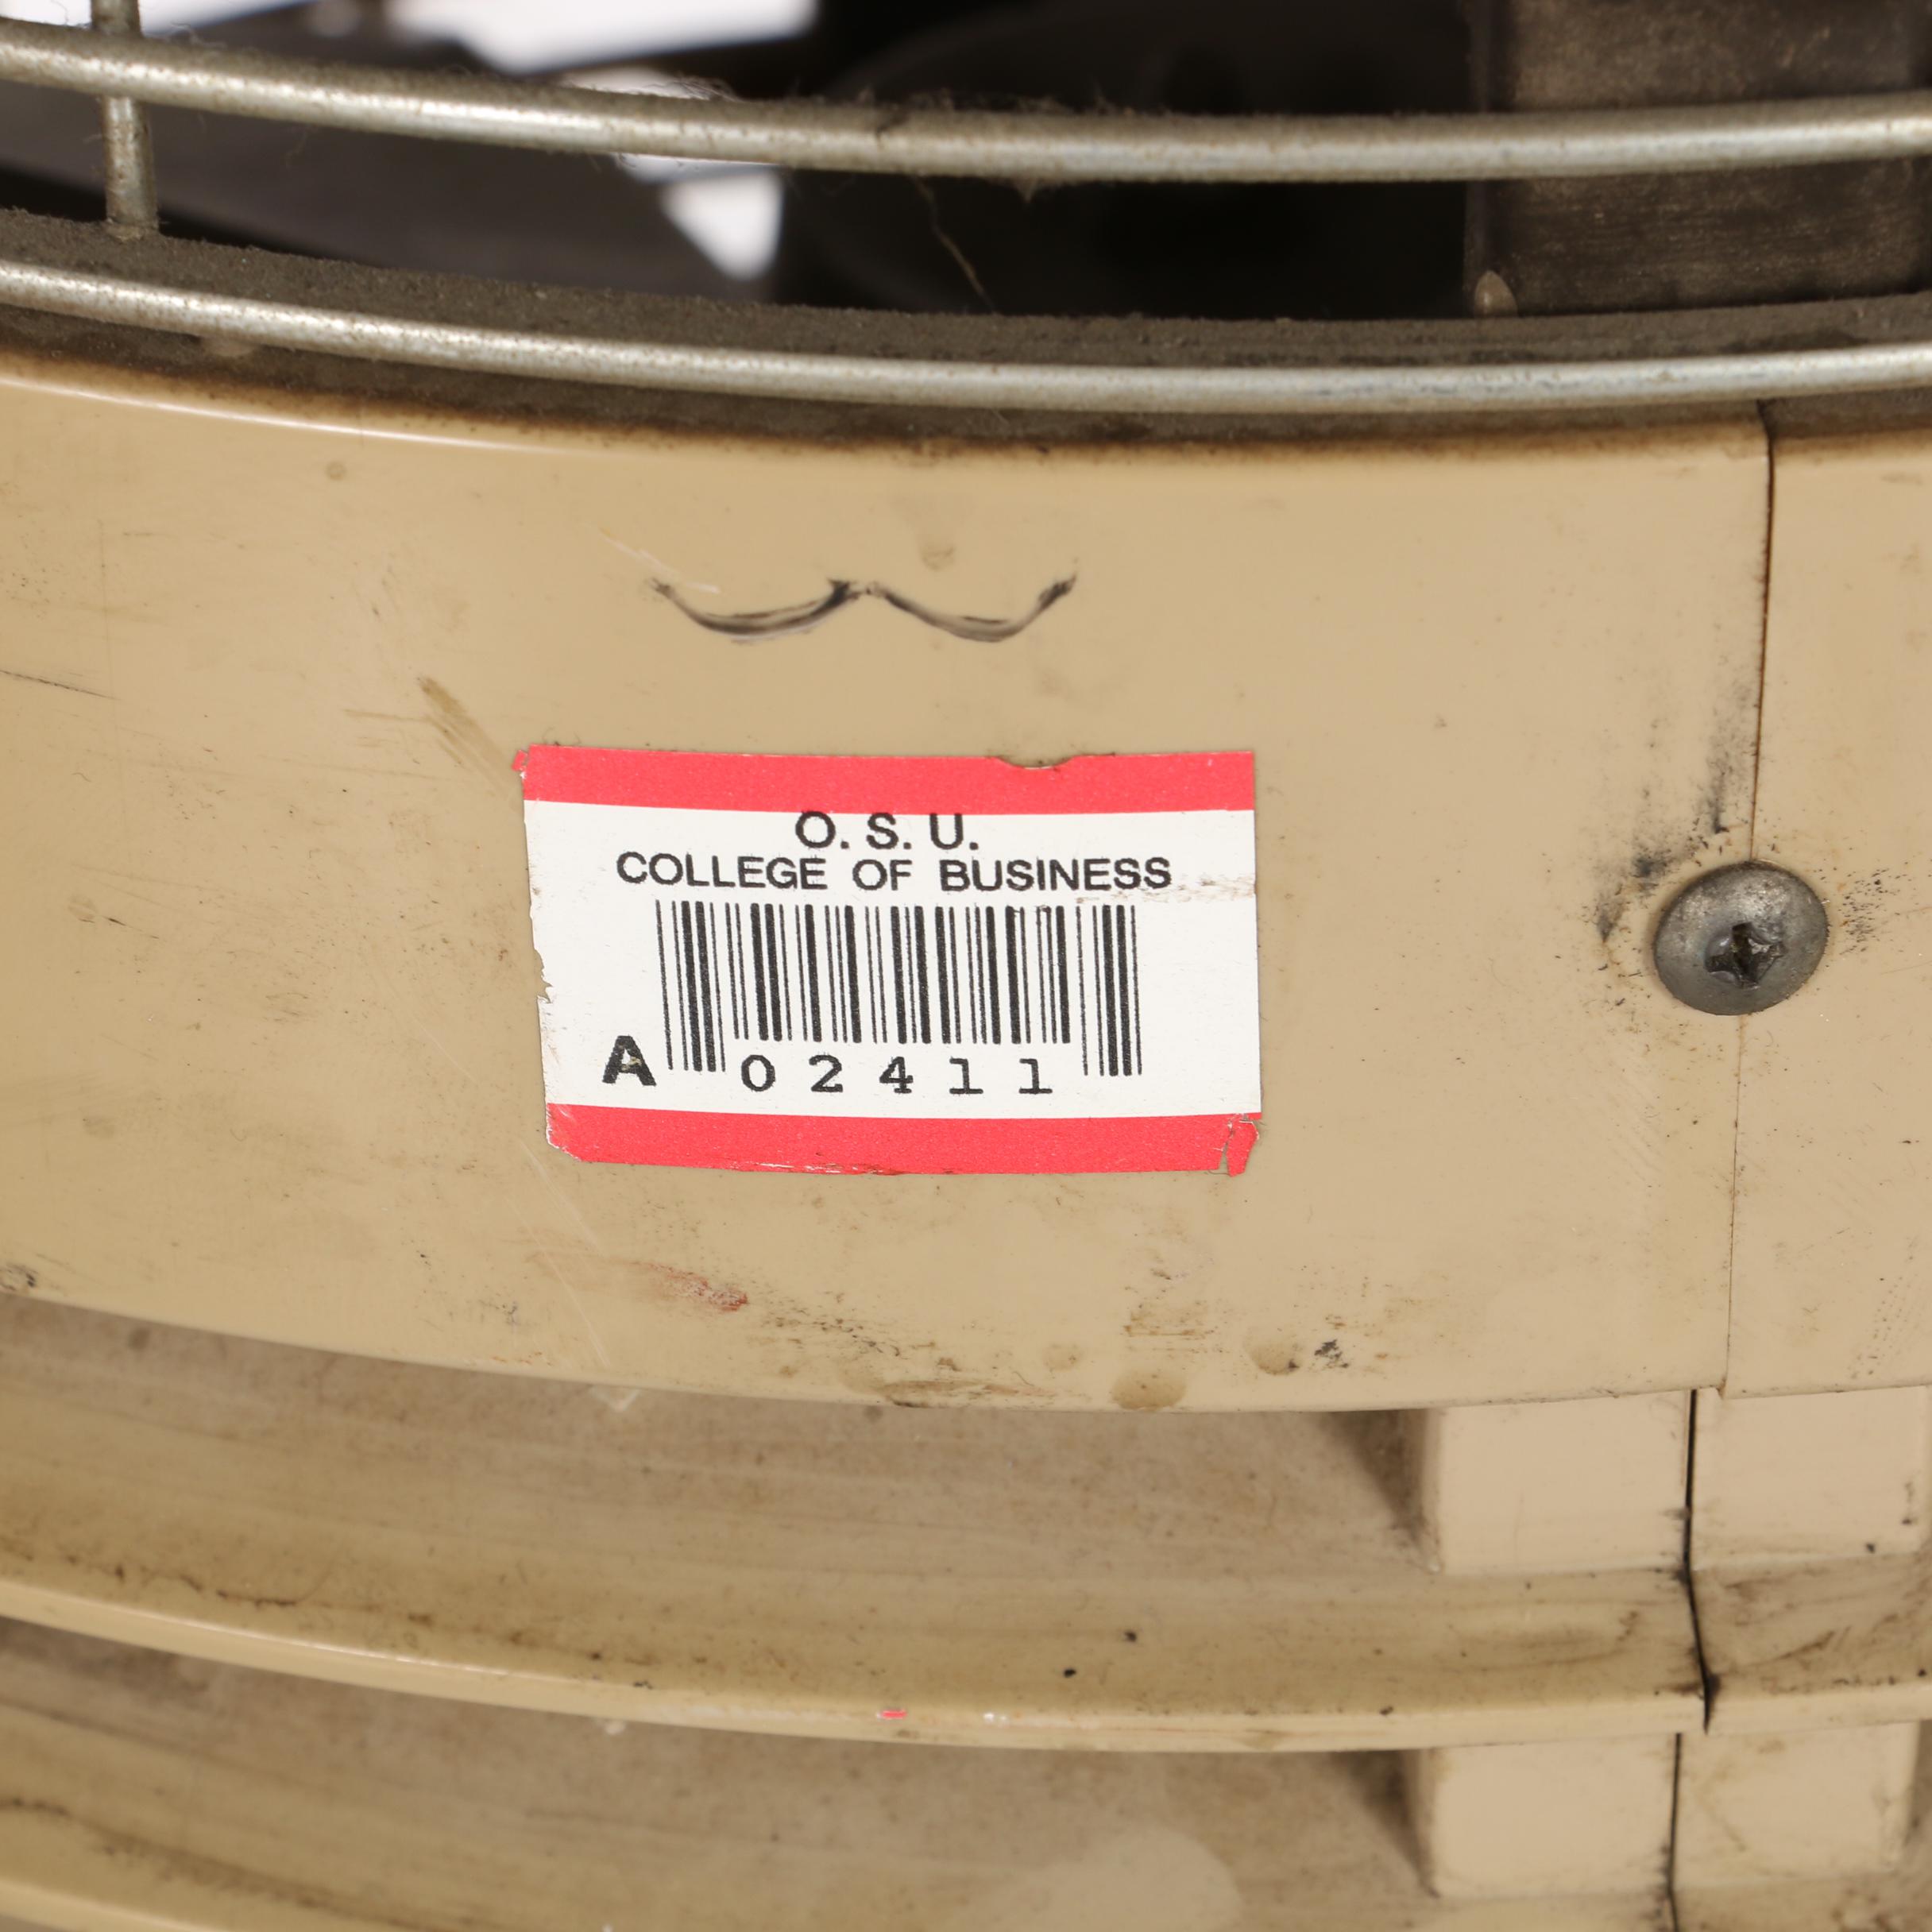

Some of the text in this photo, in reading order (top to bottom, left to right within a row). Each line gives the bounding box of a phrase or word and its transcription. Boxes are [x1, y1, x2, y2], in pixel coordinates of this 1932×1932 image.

[616, 852, 1173, 891] COLLEGE OF BUSINESS
[601, 1035, 1053, 1095] A 02411
